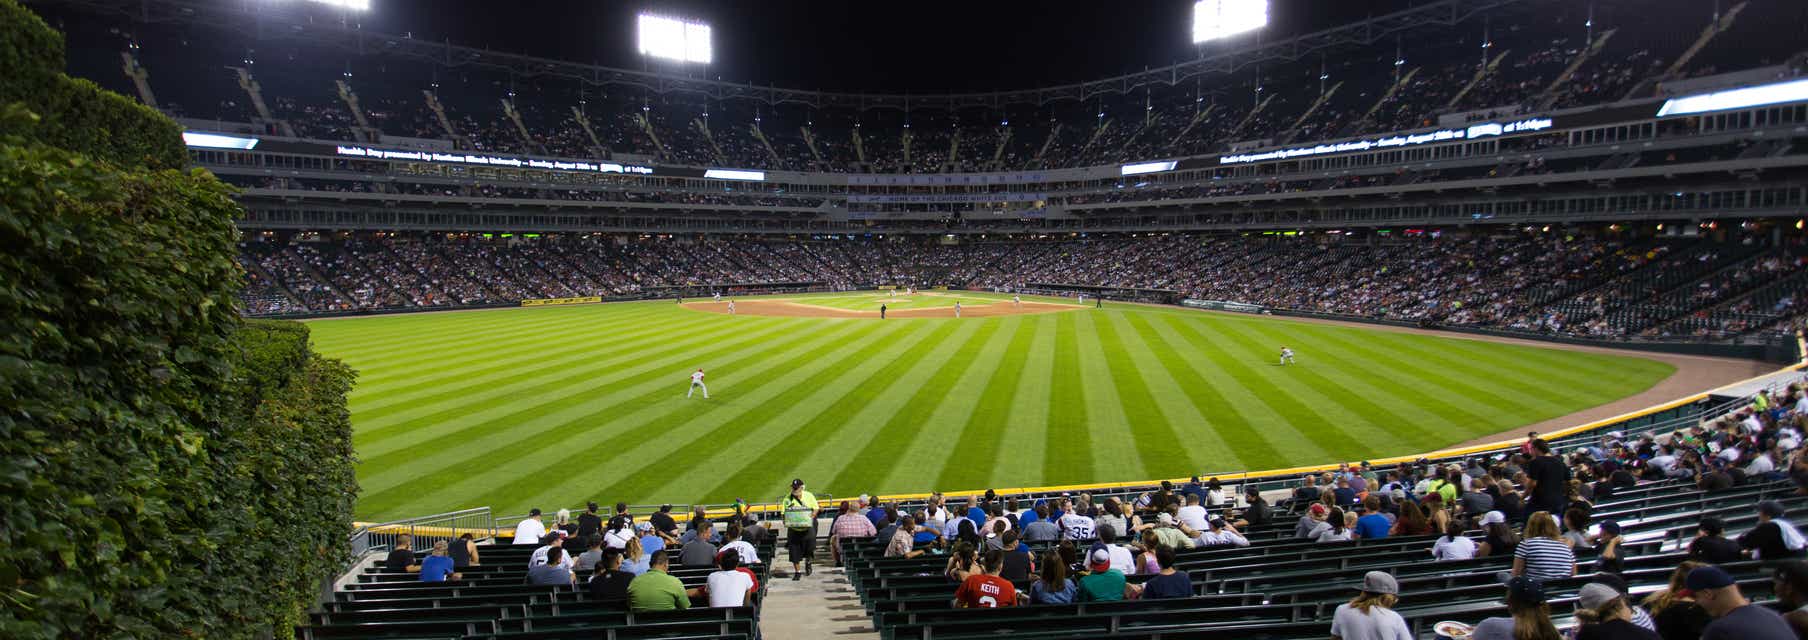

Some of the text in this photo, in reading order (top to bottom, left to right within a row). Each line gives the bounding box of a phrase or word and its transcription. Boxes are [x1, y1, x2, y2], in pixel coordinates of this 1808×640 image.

[1287, 147, 1314, 156] Northern
[1314, 144, 1336, 153] Illinois
[1336, 140, 1371, 151] University
[1406, 134, 1434, 144] August
[366, 148, 383, 158] Day
[384, 151, 421, 159] presented
[422, 152, 432, 161] by
[433, 153, 464, 162] Northern
[465, 155, 489, 163] Illinois
[489, 157, 521, 167] University
[554, 161, 576, 169] August
[1071, 526, 1089, 540] 35
[980, 583, 1000, 595] KEITH
